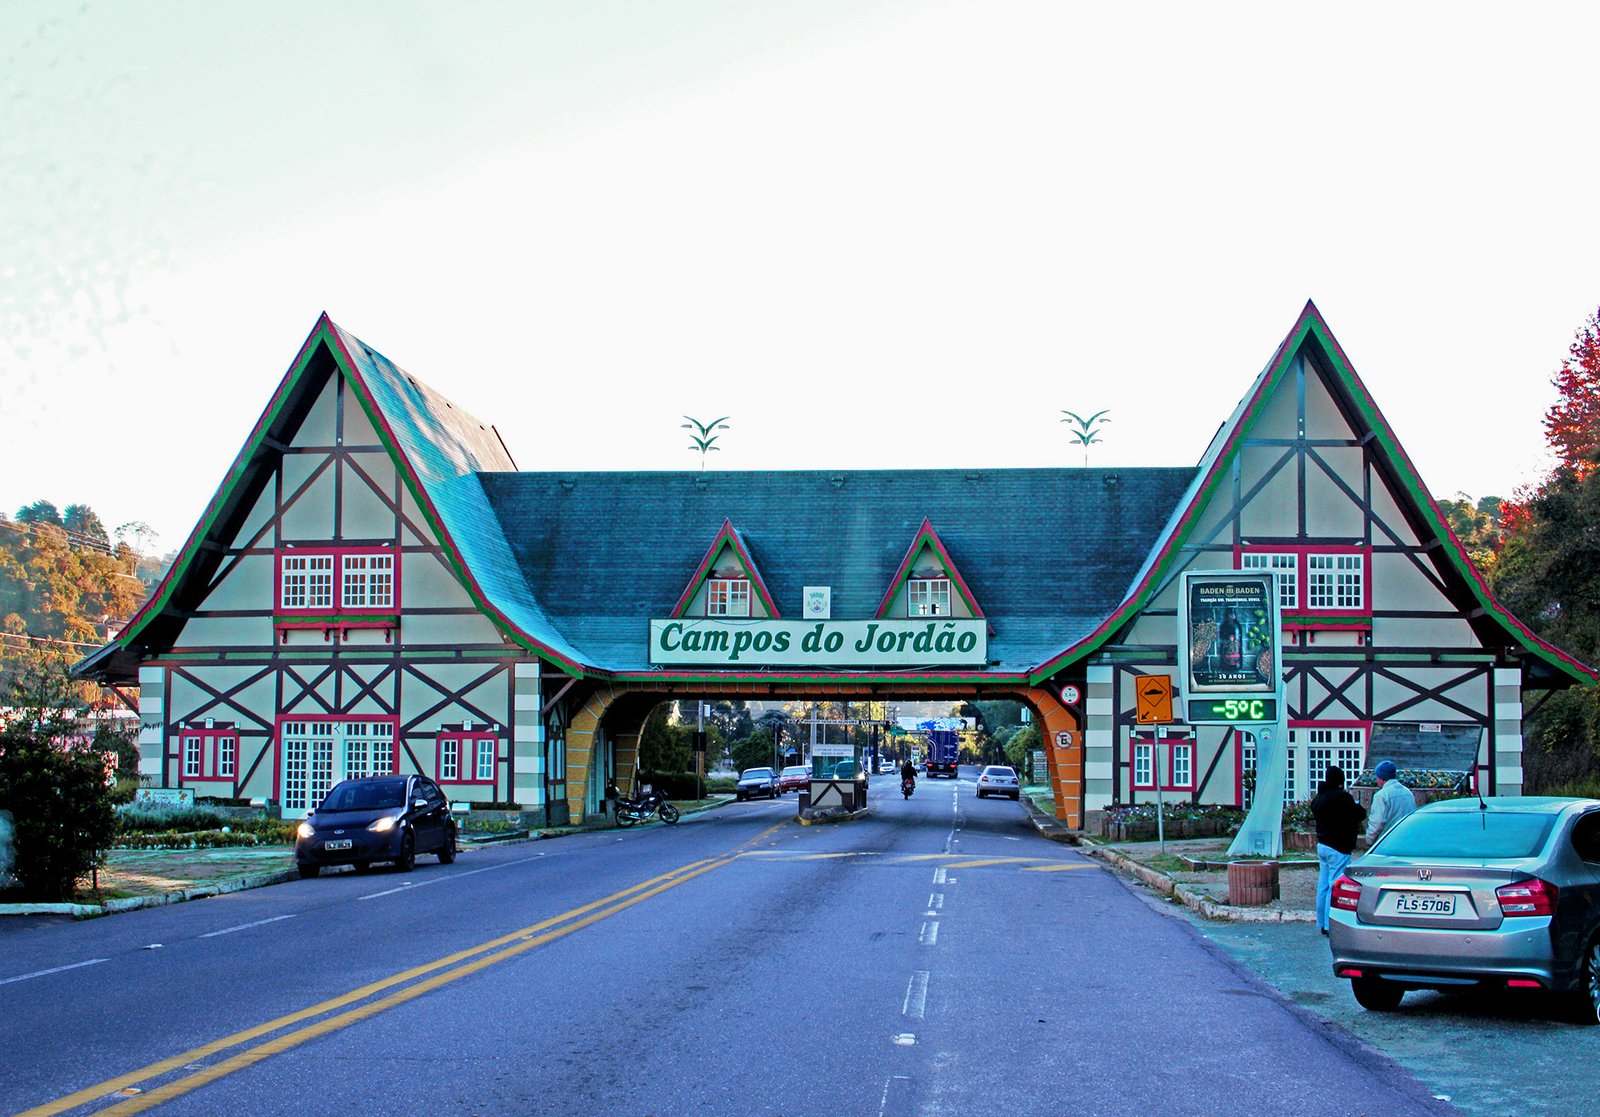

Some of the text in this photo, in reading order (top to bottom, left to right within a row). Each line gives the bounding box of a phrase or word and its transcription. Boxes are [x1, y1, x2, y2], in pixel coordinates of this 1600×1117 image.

[659, 622, 977, 660] Campos do Jordão
